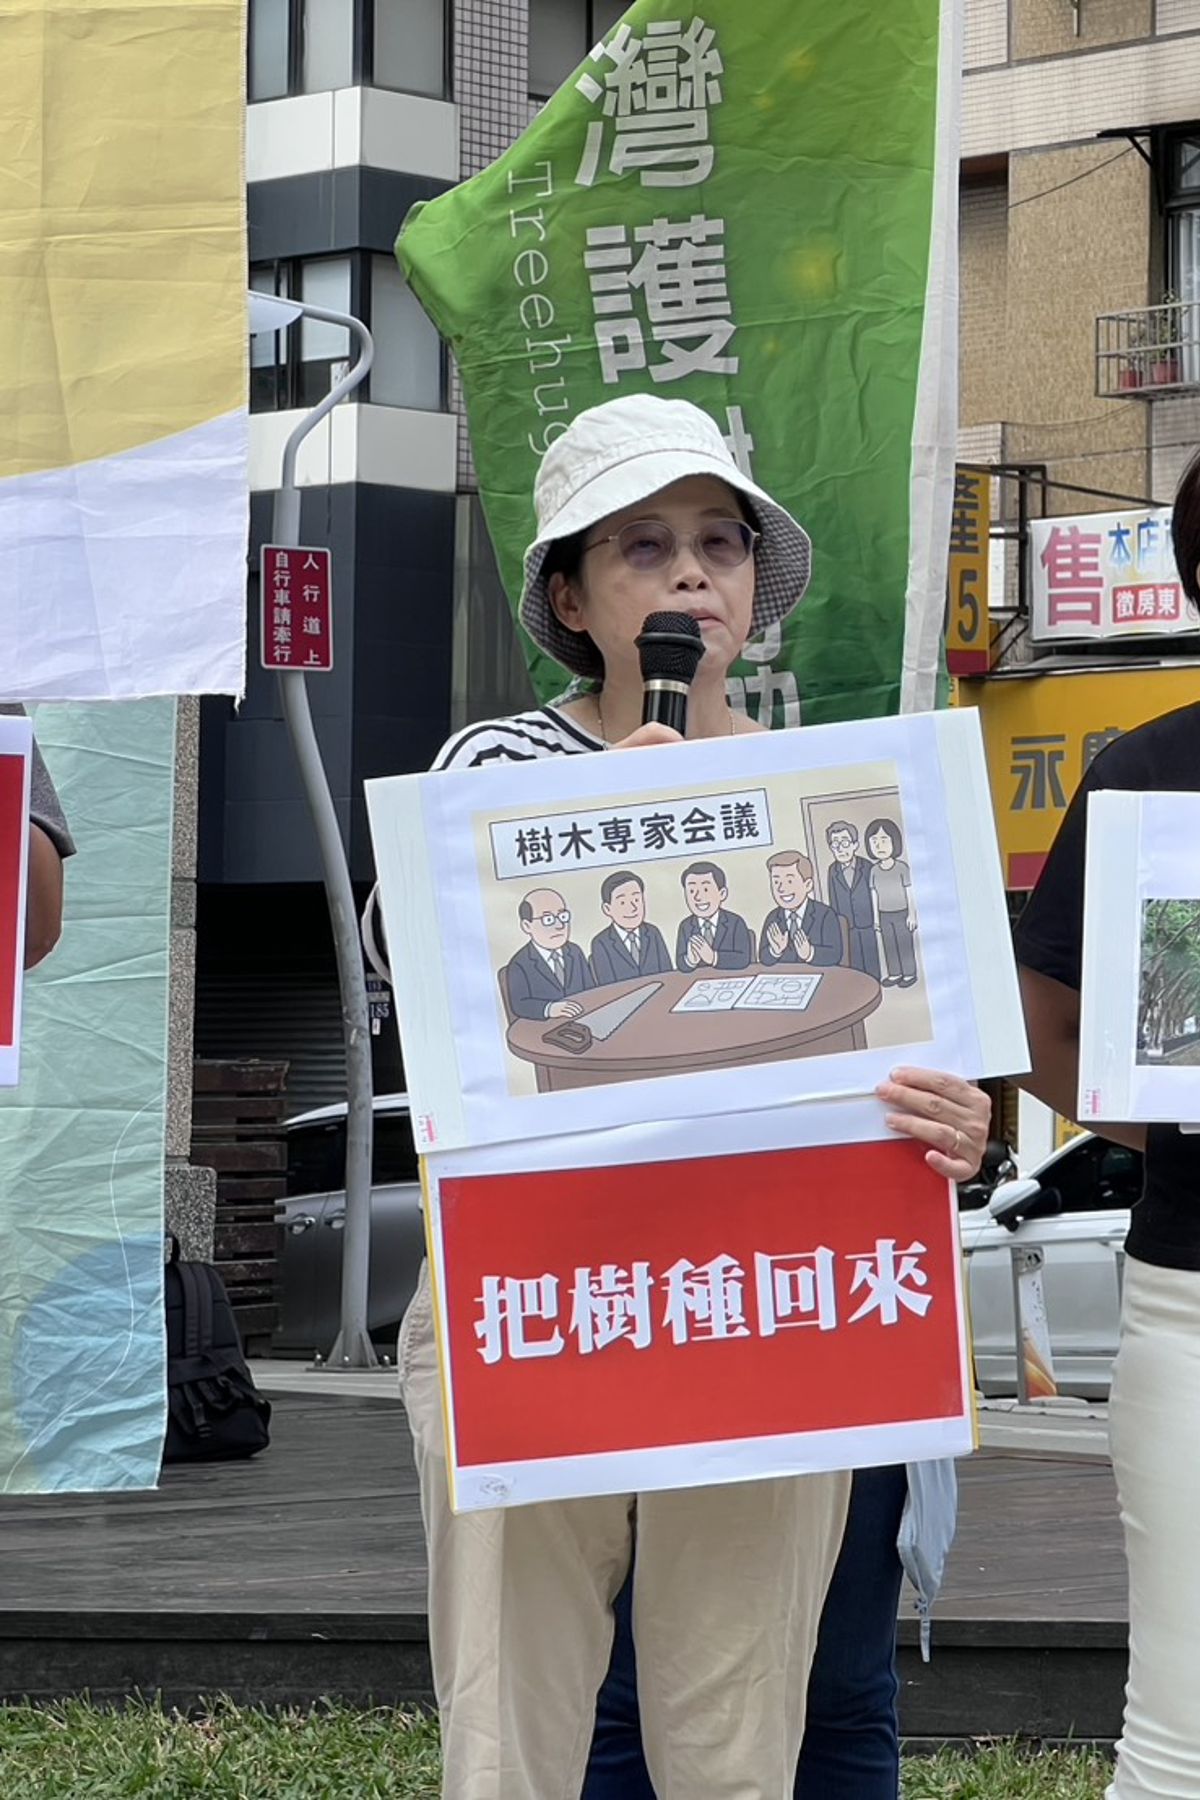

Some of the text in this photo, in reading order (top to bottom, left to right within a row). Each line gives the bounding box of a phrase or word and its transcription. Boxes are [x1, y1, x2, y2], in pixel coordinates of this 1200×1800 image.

[1040, 525, 1104, 627] 售
[1107, 517, 1172, 572] 本店
[273, 550, 292, 663] 自行車請牽行
[302, 552, 322, 666] 人行道上
[1116, 587, 1177, 619] 徵房東
[473, 1238, 933, 1364] 把樹種回來
